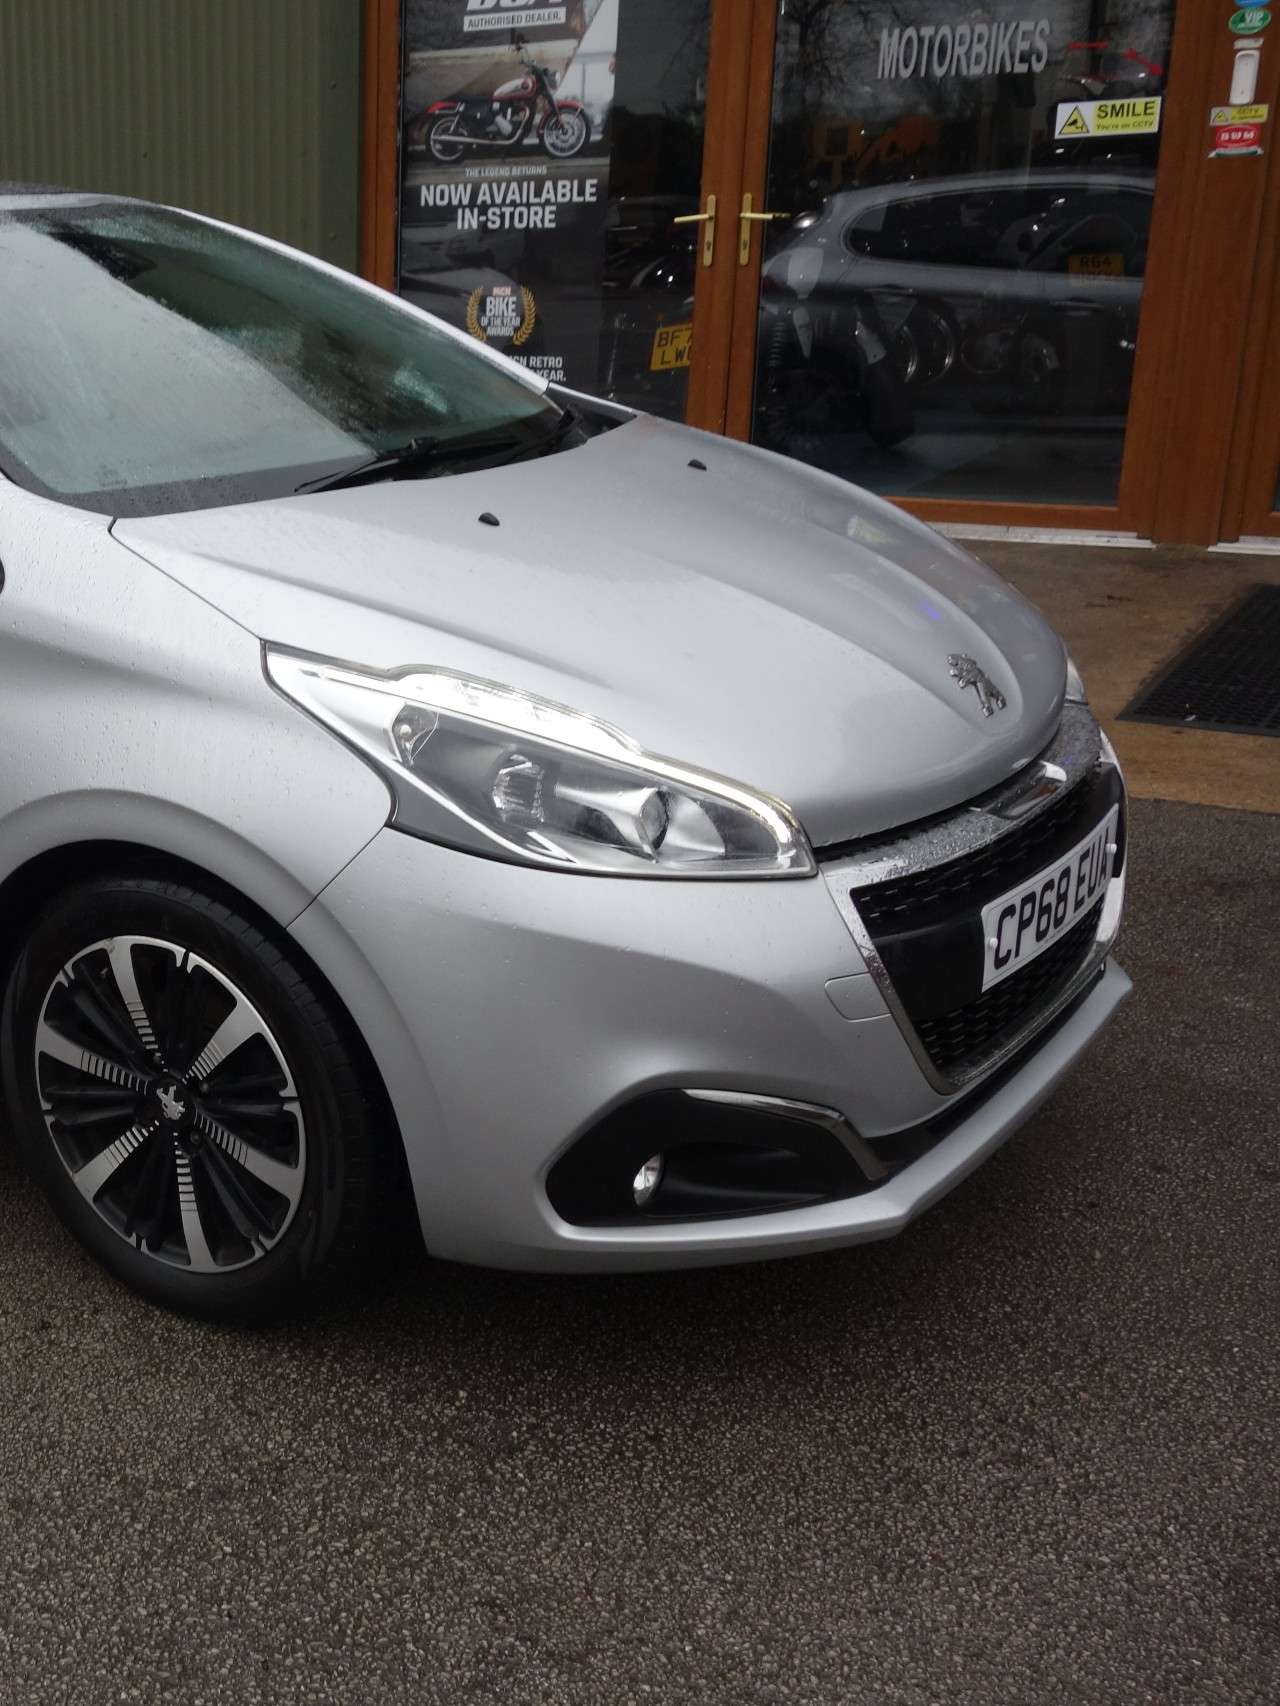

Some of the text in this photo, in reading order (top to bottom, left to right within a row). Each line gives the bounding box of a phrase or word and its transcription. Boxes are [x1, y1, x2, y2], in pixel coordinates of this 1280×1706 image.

[468, 15, 523, 28] AUTHORISED
[877, 19, 1050, 79] MOTORBIKES
[1096, 101, 1155, 119] SMILE
[1132, 120, 1154, 128] CCTV
[465, 165, 547, 177] THE LEGEND RETURNS
[420, 178, 598, 207] NOW AVAILABLE
[456, 205, 557, 230] IN-STORE
[486, 296, 516, 317] BIKE
[481, 316, 520, 327] OF THE YEAR
[486, 326, 514, 336] AWARDS
[529, 356, 562, 368] RETRO
[994, 866, 1071, 970] CP68
